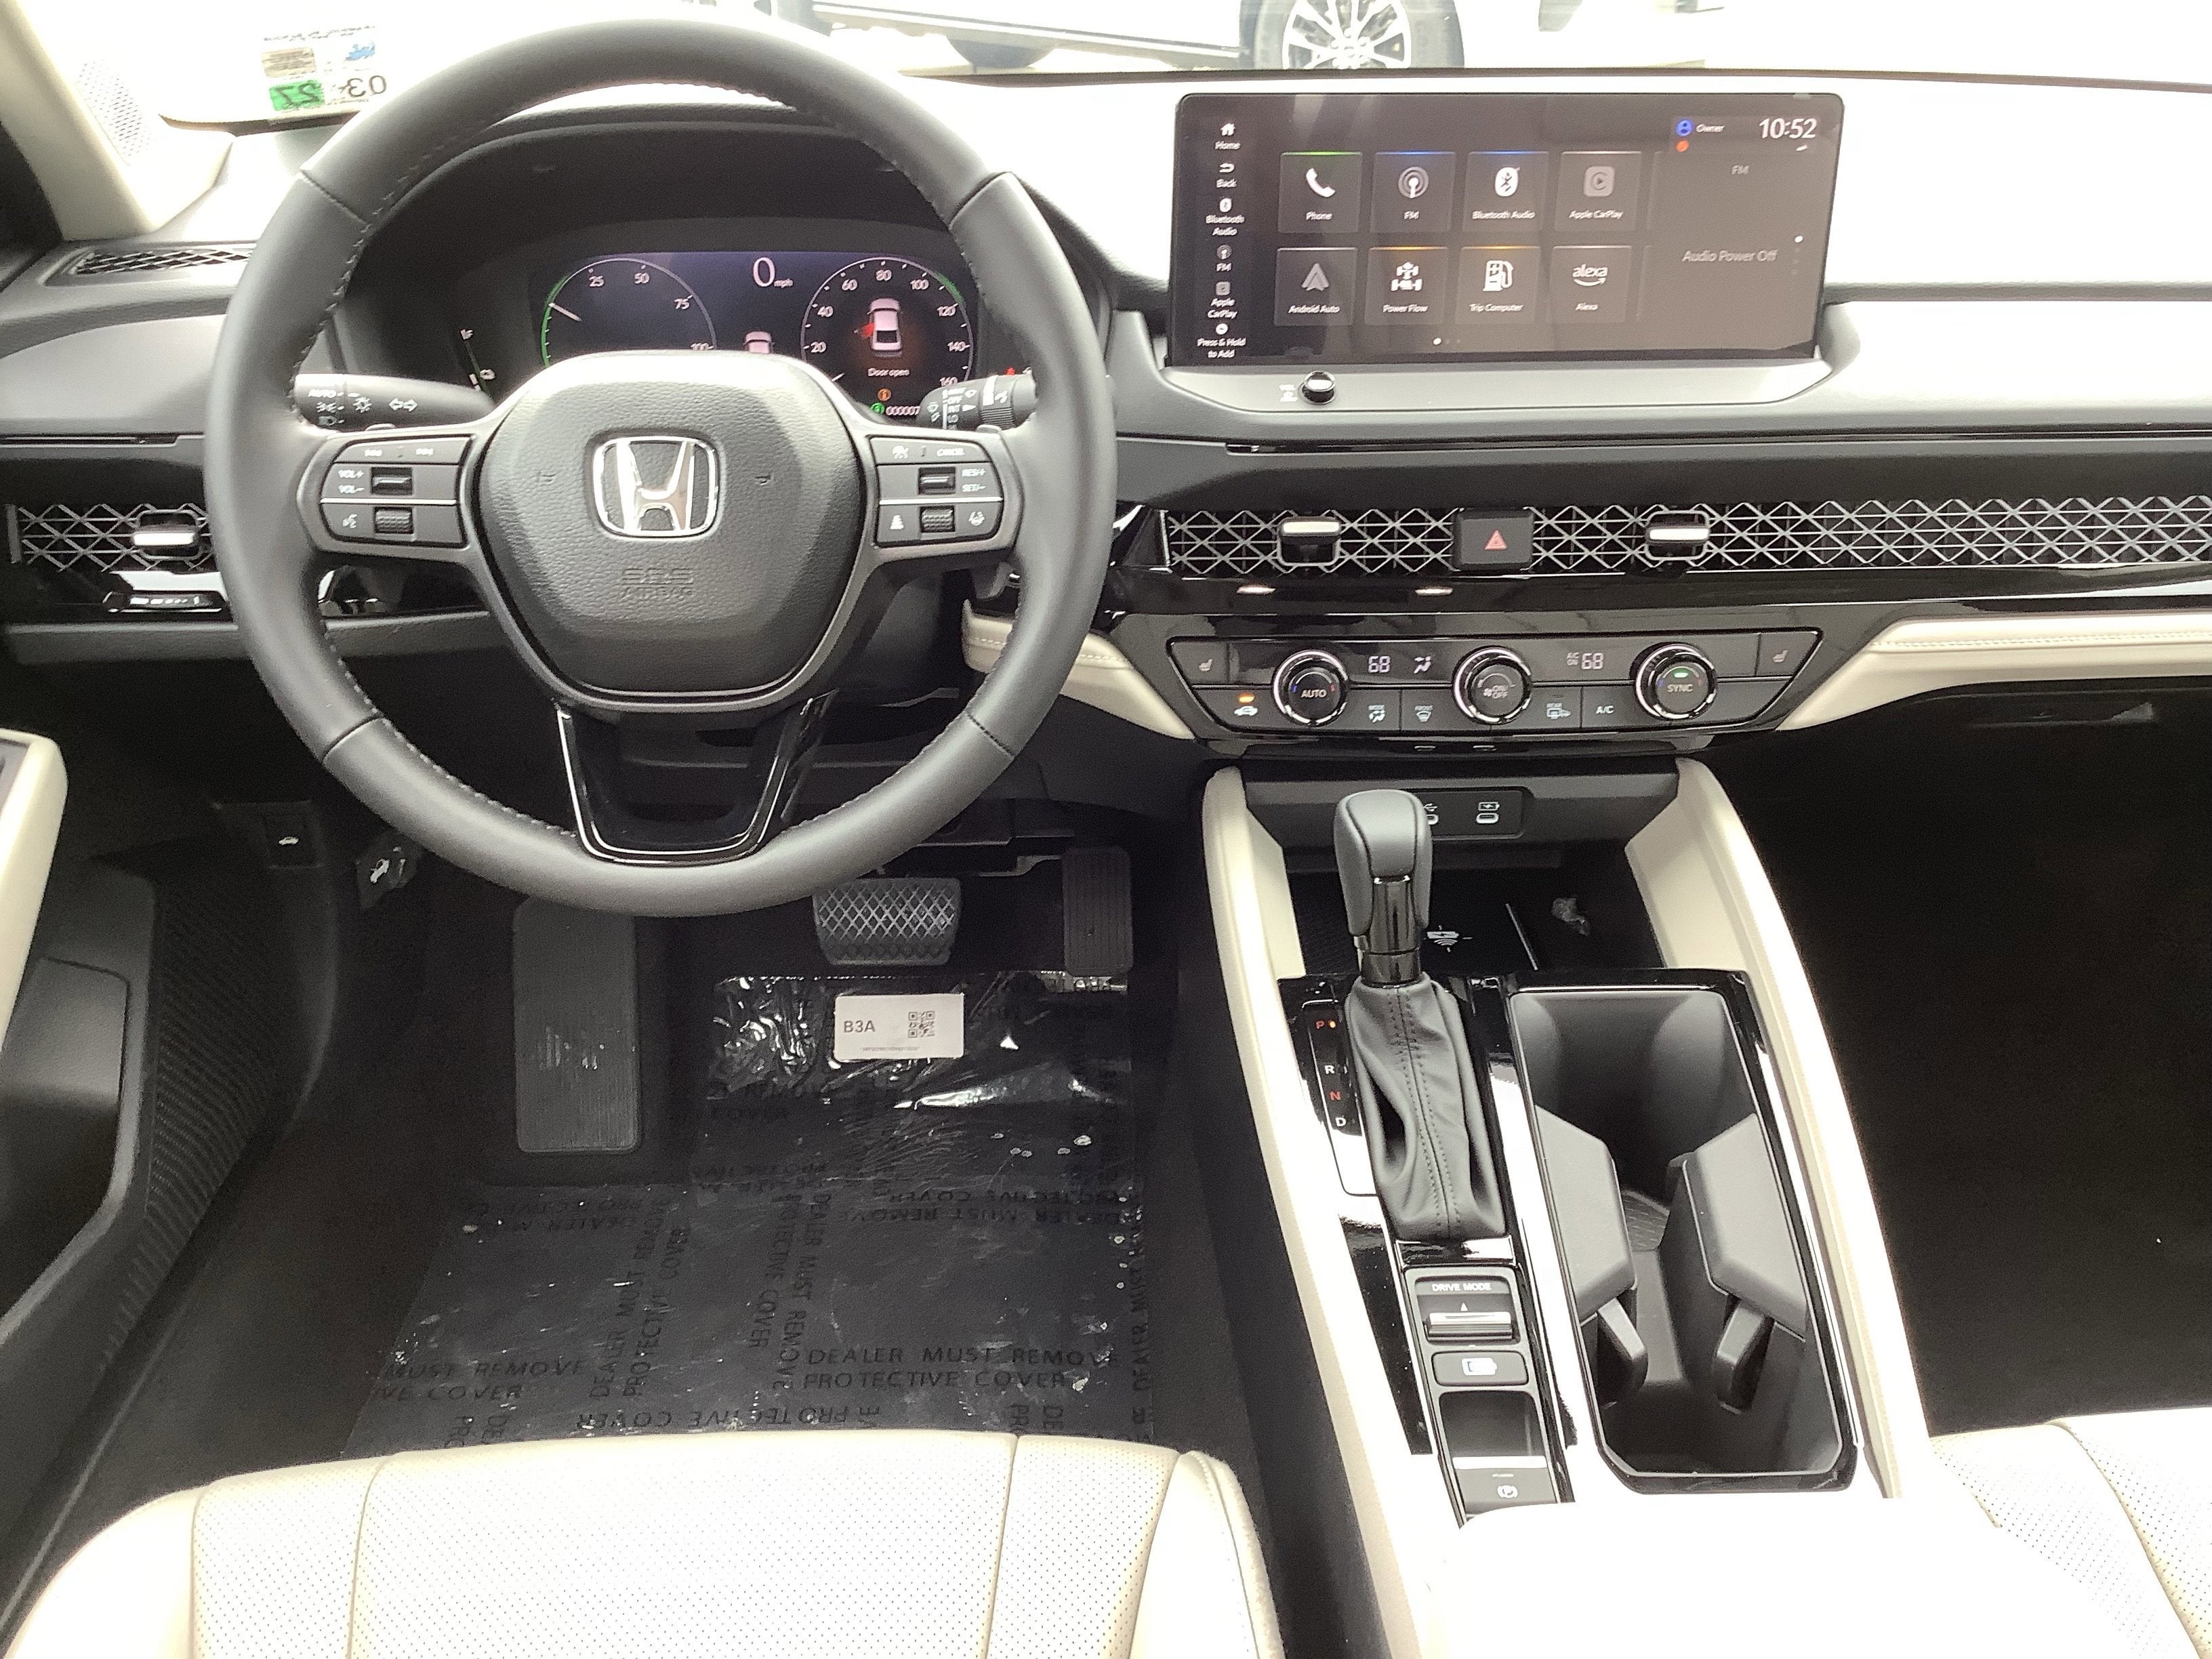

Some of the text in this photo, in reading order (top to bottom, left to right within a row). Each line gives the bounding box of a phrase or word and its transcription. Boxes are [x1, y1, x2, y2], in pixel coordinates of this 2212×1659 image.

[1696, 123, 1725, 134] Owner
[1759, 118, 1818, 140] 10:52
[1214, 141, 1241, 150] Home
[1732, 165, 1750, 175] FM
[1216, 179, 1237, 188] Back
[1206, 215, 1245, 224] Bluetooth
[1306, 211, 1333, 221] Phone
[1404, 211, 1420, 220] FM
[1472, 210, 1536, 220] Bluetooth Audio
[1569, 209, 1624, 220] Apple CarPlay
[1212, 227, 1237, 237] Audio
[1681, 249, 1779, 262] Audio Power Off
[752, 257, 794, 288] 0 mph
[1216, 263, 1231, 272] FM
[1572, 264, 1609, 279] alexa
[634, 272, 651, 285] 50
[876, 269, 893, 281] 80
[588, 275, 605, 287] 25
[842, 279, 859, 291] 60
[910, 279, 930, 290] 100
[674, 298, 691, 310] 75
[1210, 298, 1235, 308] Apple
[1382, 304, 1429, 313] Power Flow
[1469, 303, 1524, 313] Trip Computer
[1575, 302, 1599, 312] Alexa
[817, 306, 834, 317] 40
[937, 305, 957, 316] 120
[1207, 310, 1238, 319] CarPlay
[1288, 304, 1340, 314] Android Auto
[810, 342, 827, 353] 20
[947, 341, 966, 352] 140
[1197, 338, 1218, 347] Press
[1226, 337, 1246, 346] Hold
[1217, 350, 1235, 358] Add
[867, 367, 910, 378] Door open
[1368, 655, 1391, 673] 68
[1580, 652, 1605, 670] 68
[1666, 683, 1694, 693] SYNC
[1300, 689, 1327, 699] AUTO
[1595, 705, 1615, 715] A/C
[842, 1019, 877, 1033] B3A
[1315, 1020, 1326, 1030] P
[1324, 1065, 1336, 1075] R
[1328, 1090, 1342, 1101] N
[1334, 1116, 1347, 1127] D
[1431, 1282, 1492, 1292] DRIVE MODE
[808, 1347, 903, 1365] DEALER
[922, 1347, 994, 1364] MUST
[802, 1370, 1067, 1390] PROTECTIVE COVER
[427, 1384, 523, 1401] COVER
